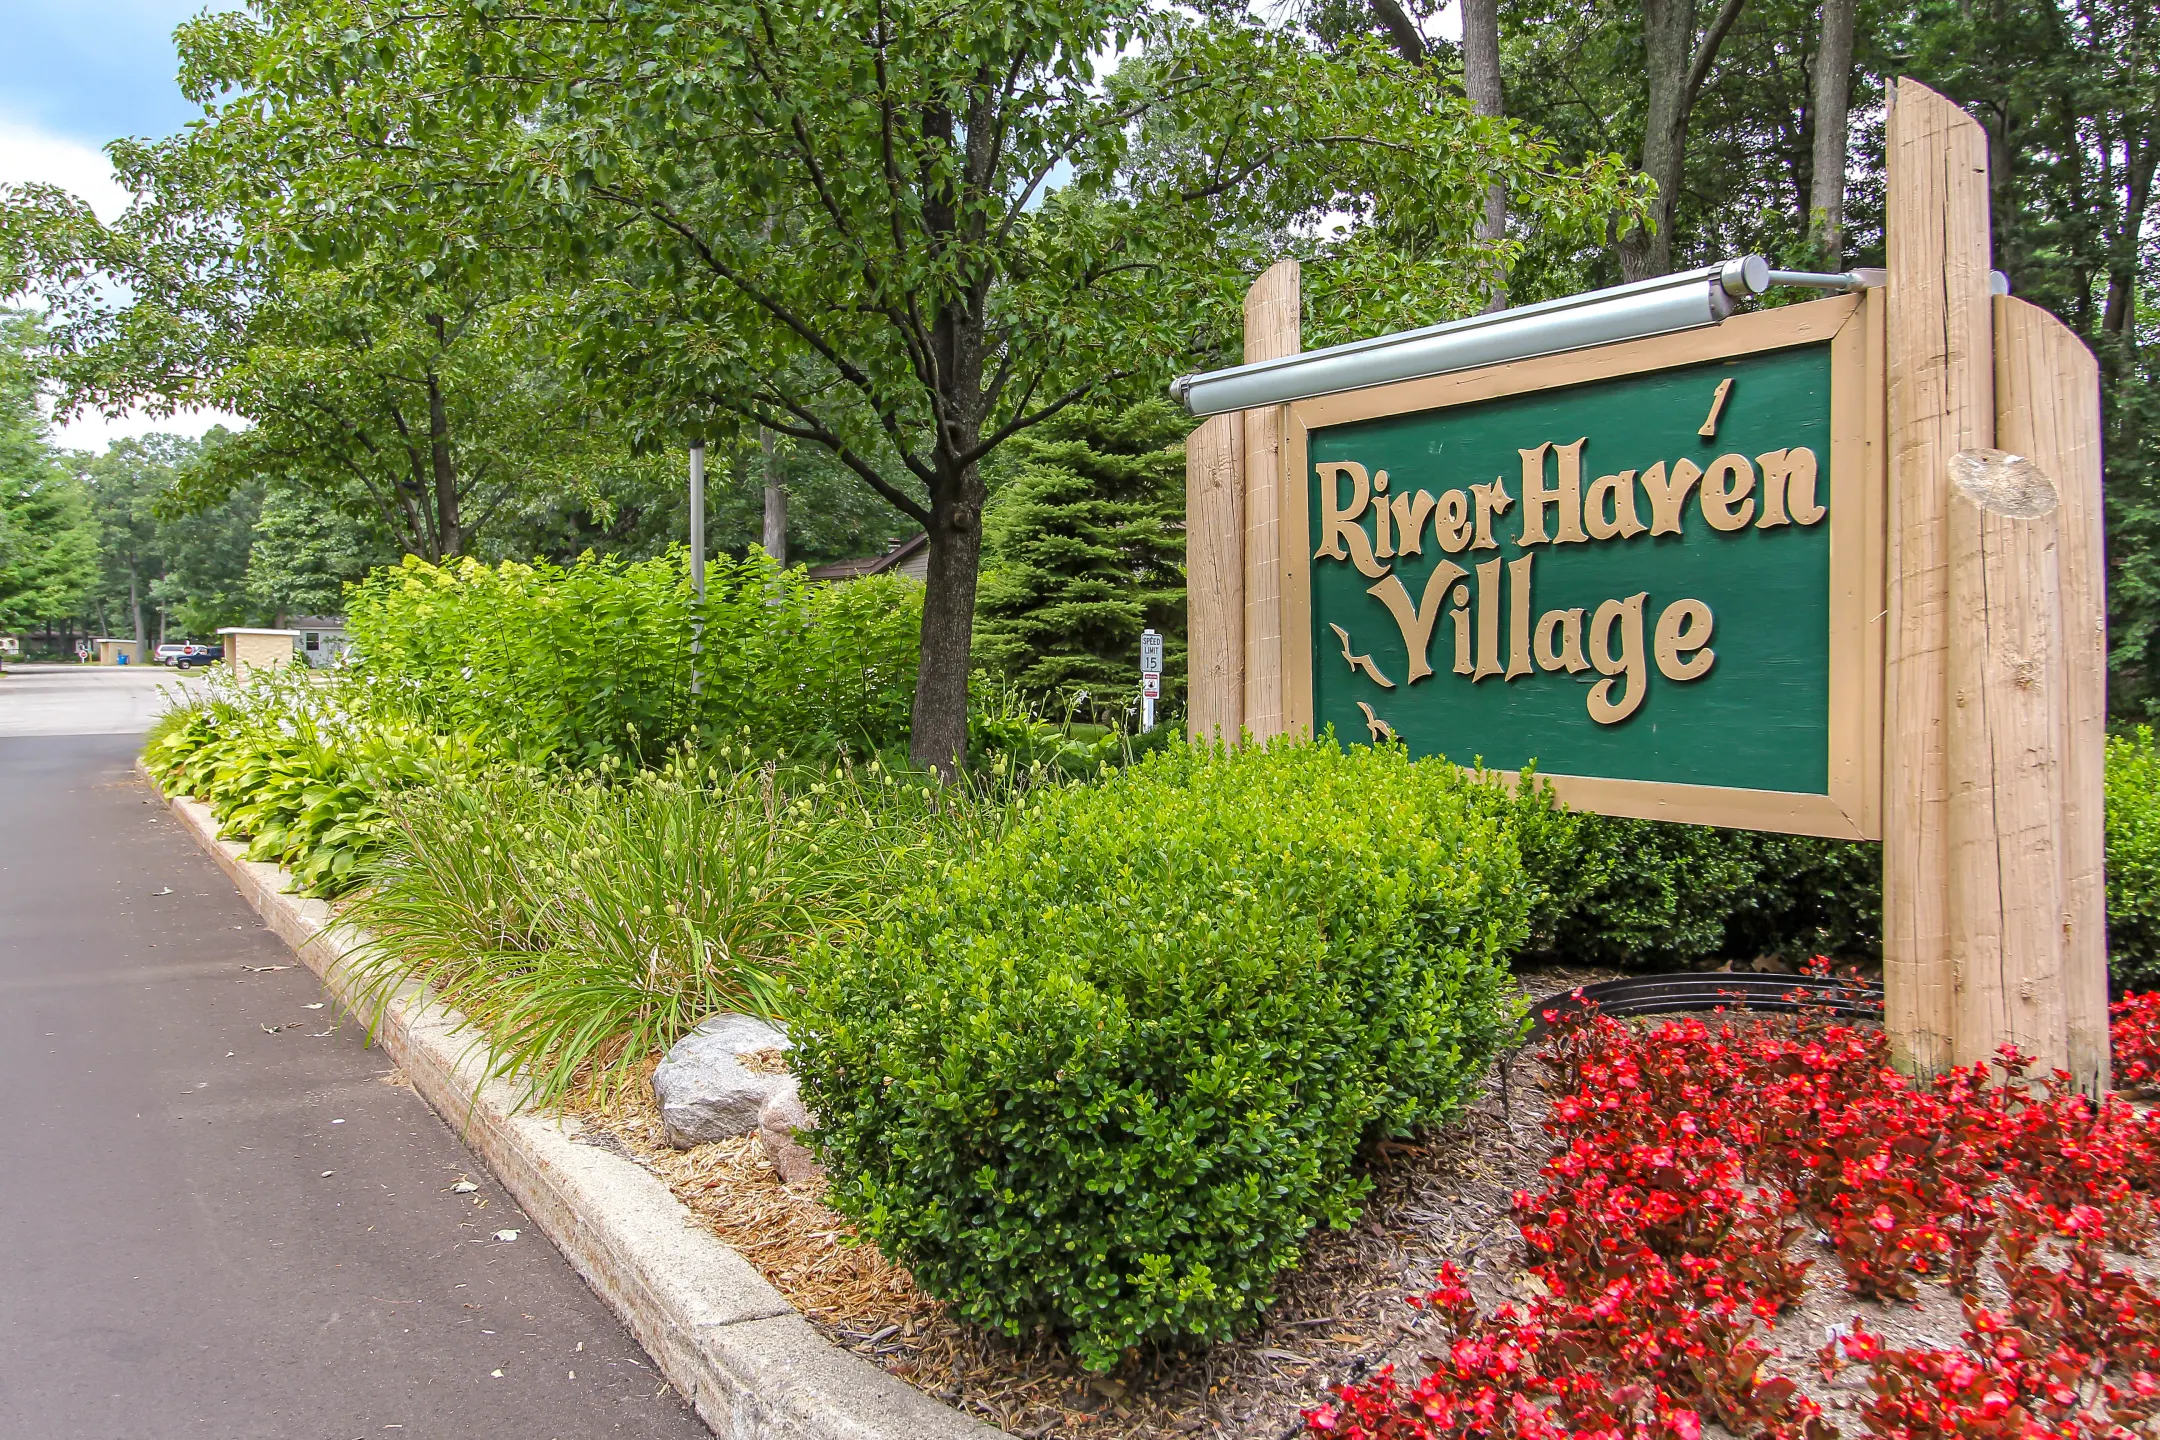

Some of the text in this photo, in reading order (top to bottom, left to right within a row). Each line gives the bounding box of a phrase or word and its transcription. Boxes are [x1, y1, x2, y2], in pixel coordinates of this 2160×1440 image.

[1314, 436, 1828, 578] River Haven
[1142, 637, 1161, 646] SPEED
[1367, 552, 1716, 725] Village
[1144, 646, 1159, 655] LIMIT
[1145, 656, 1157, 669] 15
